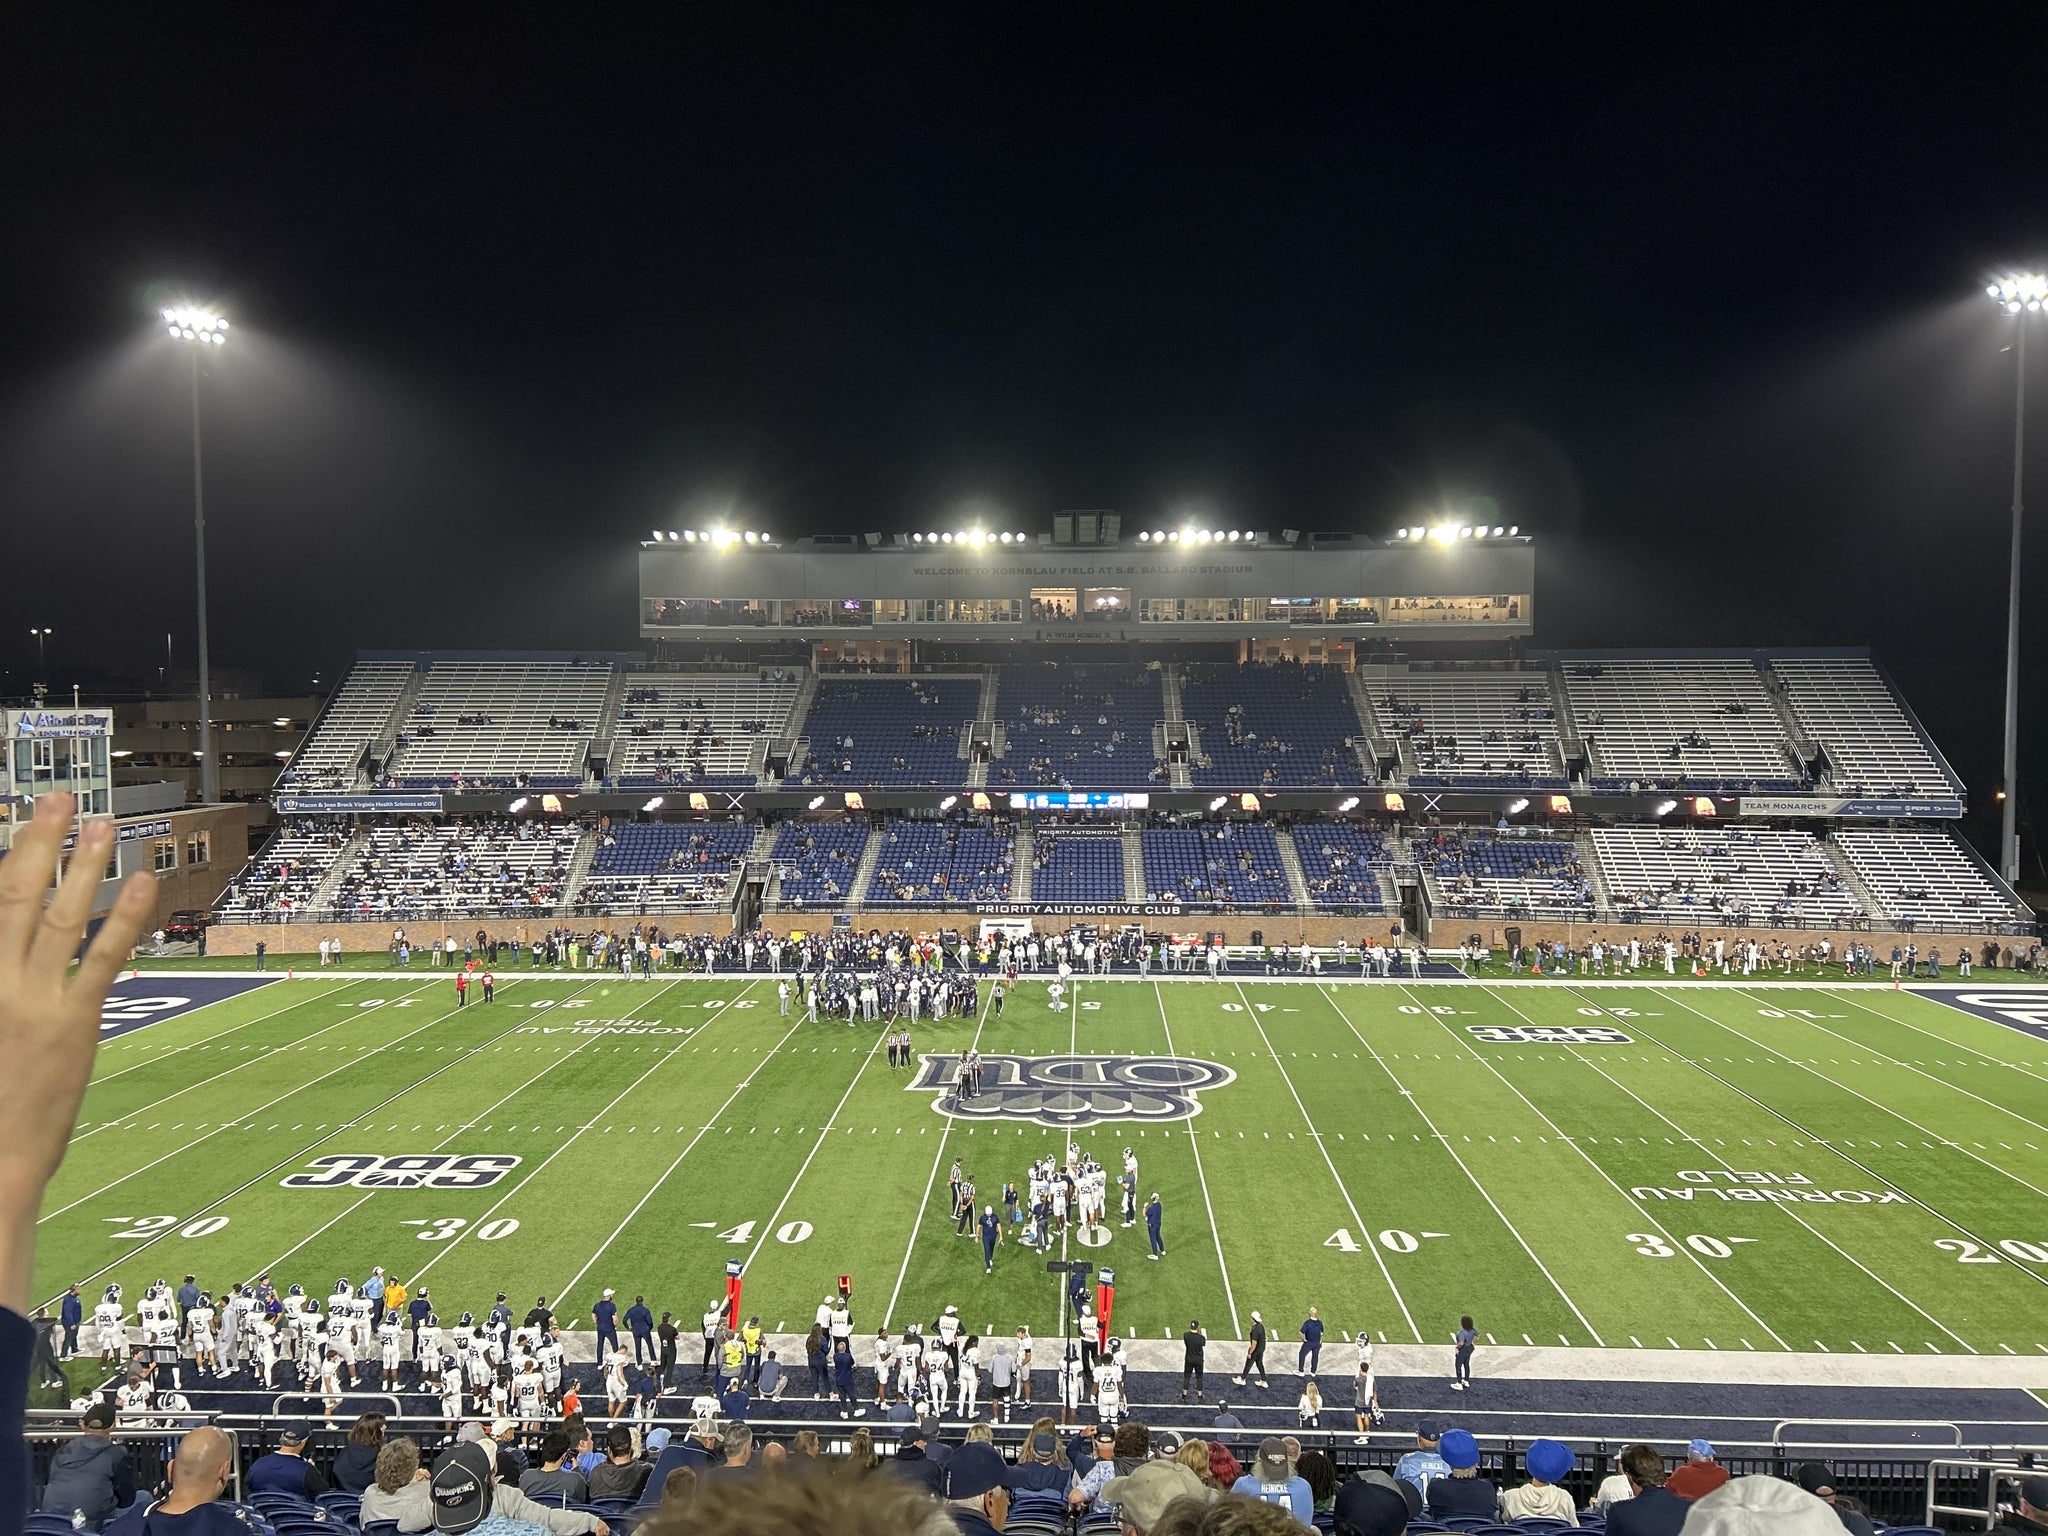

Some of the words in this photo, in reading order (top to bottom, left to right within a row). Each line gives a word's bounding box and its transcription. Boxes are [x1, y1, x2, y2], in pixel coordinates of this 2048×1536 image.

[914, 567, 970, 576] WELCOME
[974, 567, 989, 576] TO
[993, 567, 1056, 575] KORNBLAU
[1061, 567, 1094, 575] FIELD
[1098, 567, 1113, 575] AT
[1116, 566, 1138, 575] S.B.
[1142, 566, 1197, 574] BALLARD
[1200, 565, 1253, 574] STADIUM
[85, 714, 109, 728] Bay
[353, 801, 375, 810] Virginia
[1773, 803, 1827, 811] MONARCHS
[976, 905, 1040, 914] PRIORITY
[1044, 905, 1140, 914] AUTOMOTIVE
[1144, 905, 1181, 915] CLUB
[515, 1026, 697, 1034] KORNBLAU
[903, 1054, 1238, 1093] ODU
[1676, 1170, 1814, 1185] FIELD
[1056, 1189, 1066, 1198] 33
[1630, 1187, 1910, 1204] KORNBLAU
[108, 1215, 230, 1238] 20
[416, 1217, 520, 1240] 30
[715, 1220, 814, 1244] 40
[1323, 1228, 1419, 1253] 40
[1625, 1233, 1733, 1258] 30
[1933, 1238, 2048, 1263] 20
[839, 1277, 852, 1294] 4
[331, 1326, 344, 1337] 57
[382, 1336, 393, 1346] 21
[424, 1339, 430, 1347] 7
[549, 1358, 558, 1366] 11
[906, 1356, 913, 1366] 5
[930, 1363, 944, 1373] 24
[128, 1394, 144, 1407] 64
[1421, 1461, 1443, 1470] HEINICKE
[435, 1481, 475, 1497] CHAMPIONS
[1261, 1483, 1288, 1494] HEINICKE
